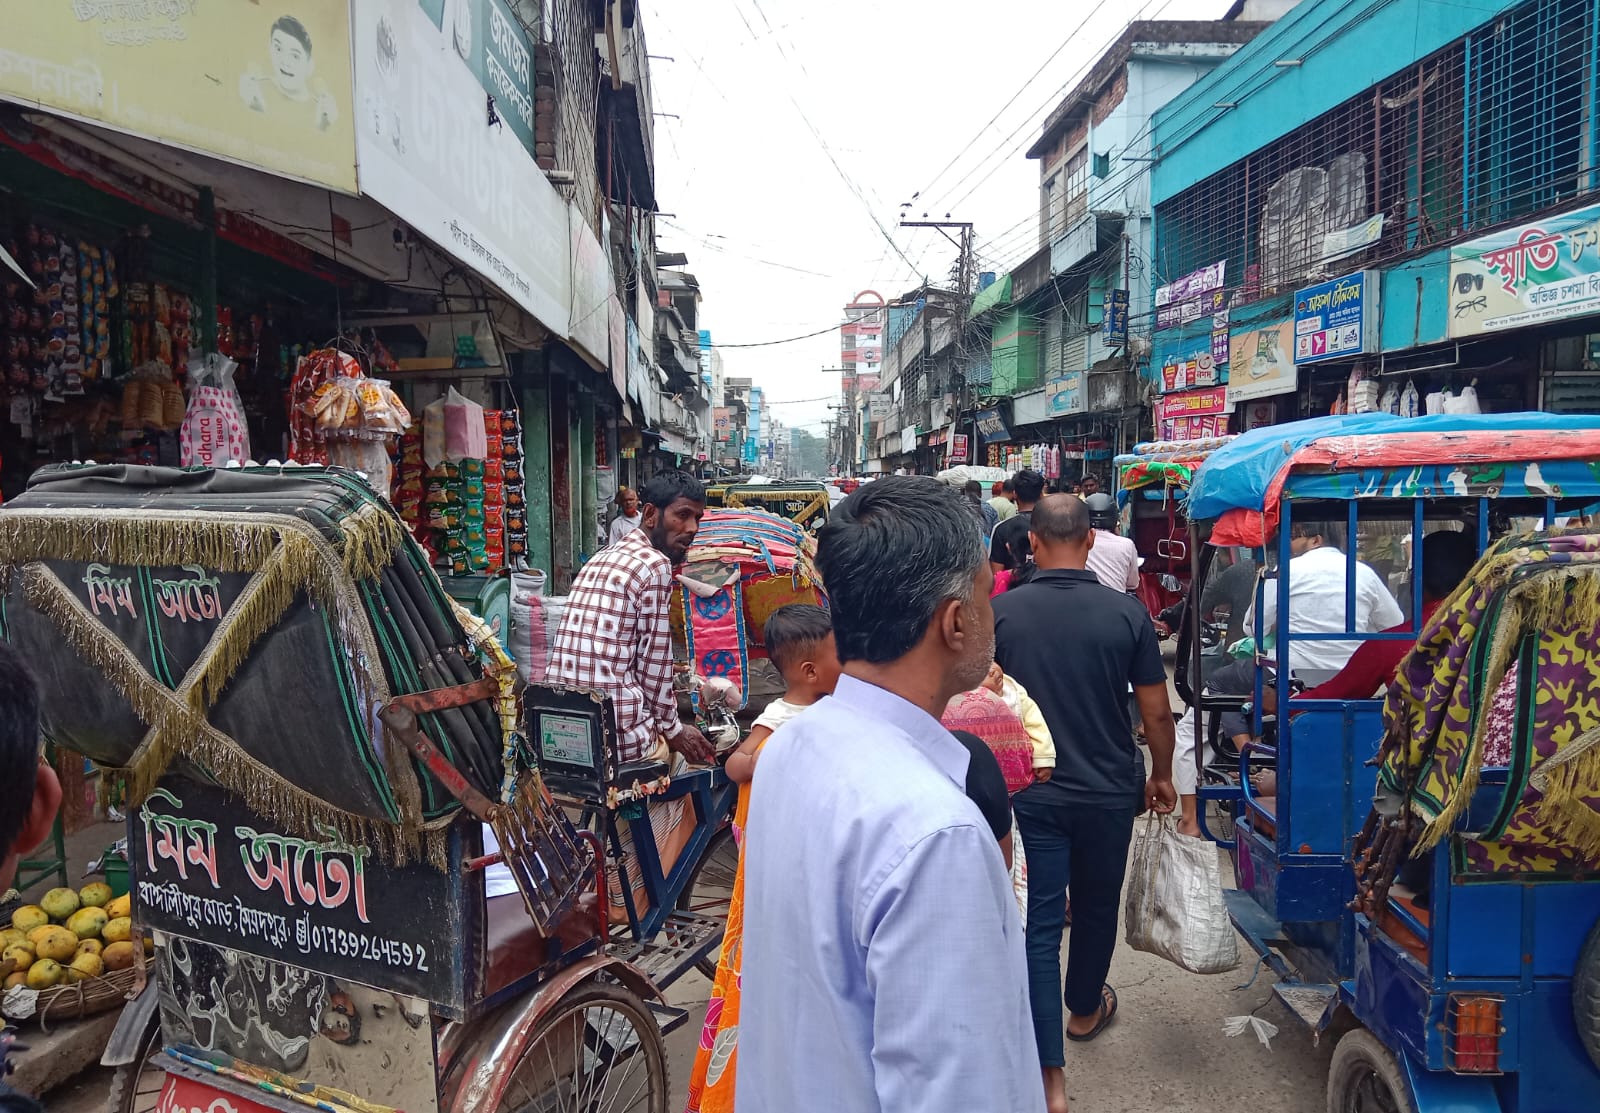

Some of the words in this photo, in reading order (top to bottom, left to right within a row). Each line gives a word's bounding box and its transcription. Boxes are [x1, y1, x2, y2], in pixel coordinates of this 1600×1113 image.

[489, 0, 531, 92] জমজম
[1481, 229, 1563, 296] স্মৃতি
[1529, 286, 1559, 305] অভিজ্ঞ
[1561, 281, 1586, 299] চশমা
[216, 417, 225, 449] Tissue
[84, 564, 136, 620] মিম
[153, 564, 222, 623] অটো
[140, 788, 220, 889] মিম
[235, 818, 372, 924] অটো
[312, 927, 430, 973] 01739264592
